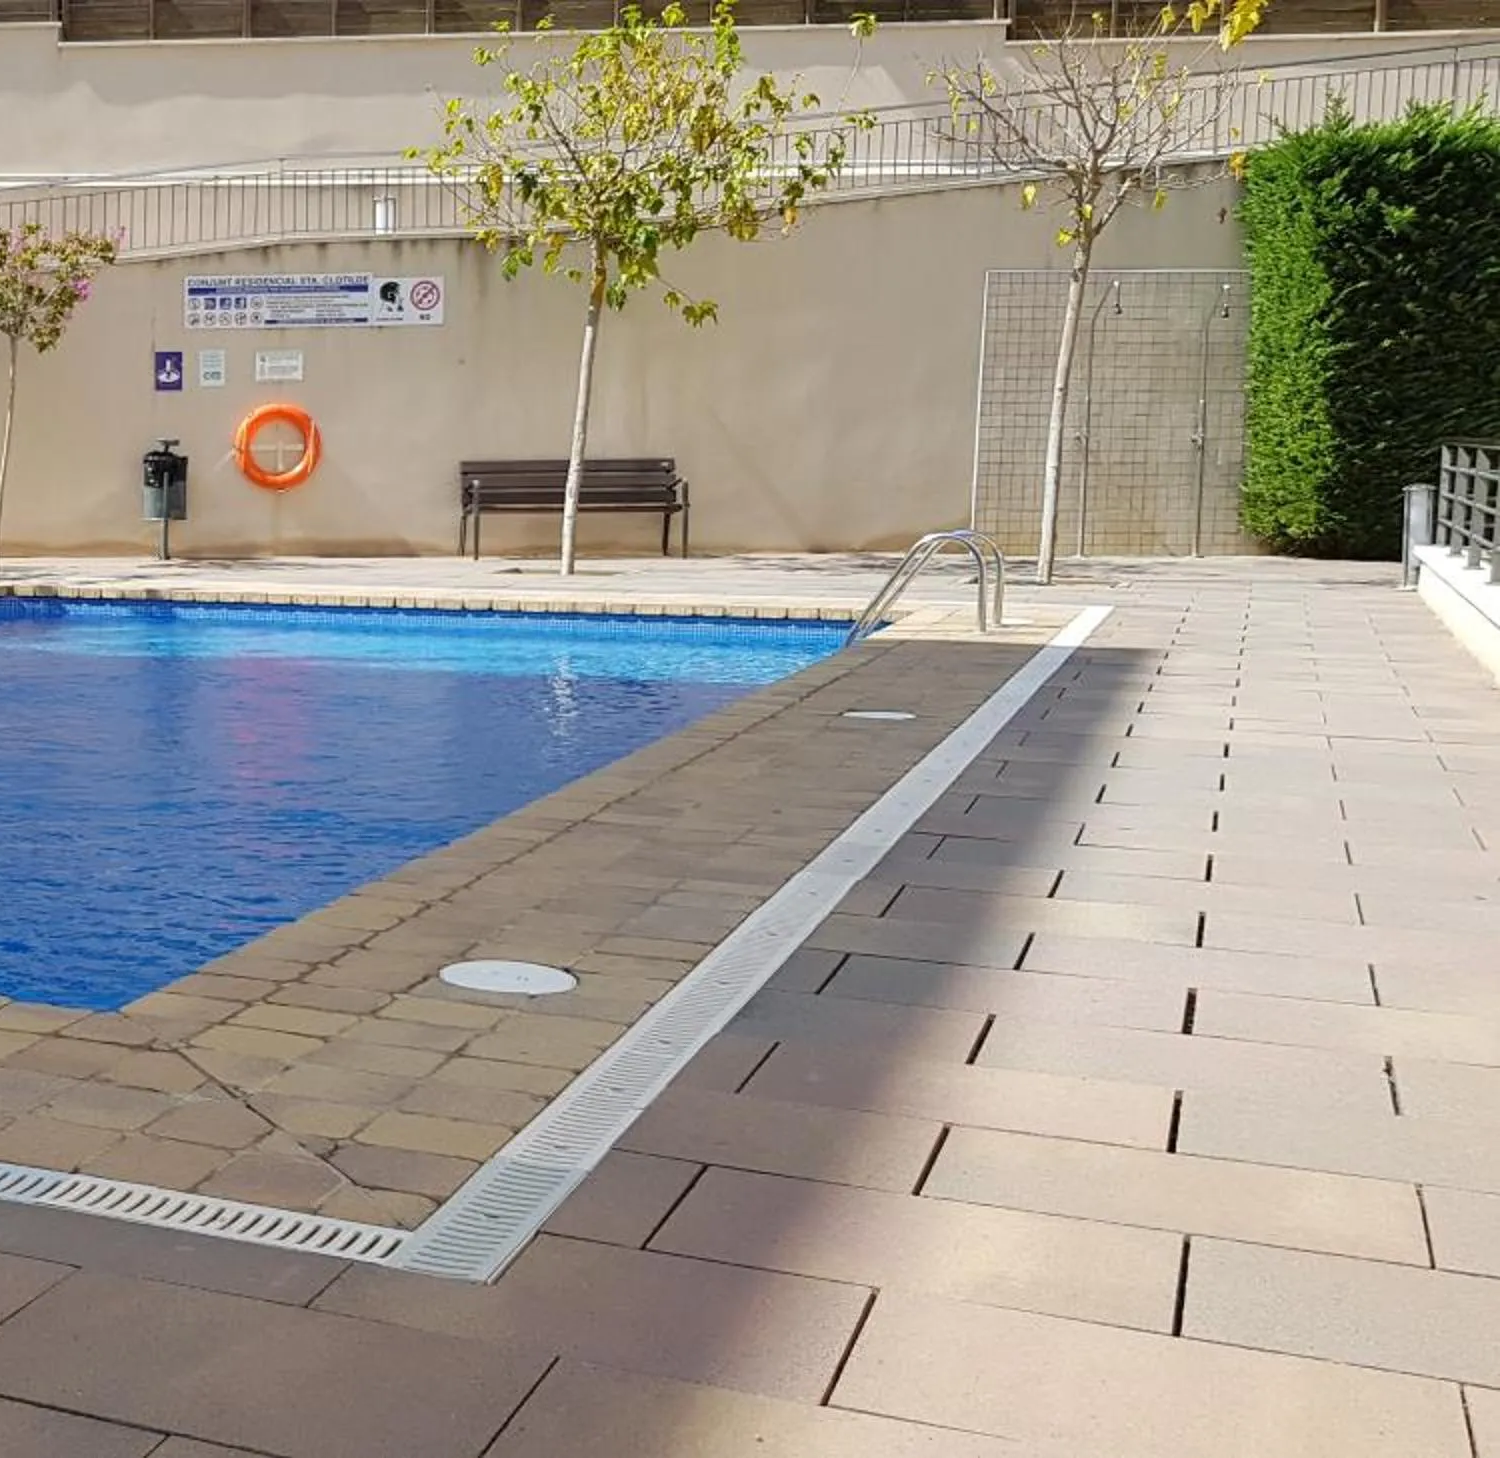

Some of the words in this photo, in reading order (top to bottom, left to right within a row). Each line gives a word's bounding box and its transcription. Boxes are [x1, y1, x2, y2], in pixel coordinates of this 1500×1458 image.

[188, 278, 233, 287] CONJUNT
[236, 277, 295, 286] RESIDENCIAL
[323, 275, 368, 284] CLOTILDE
